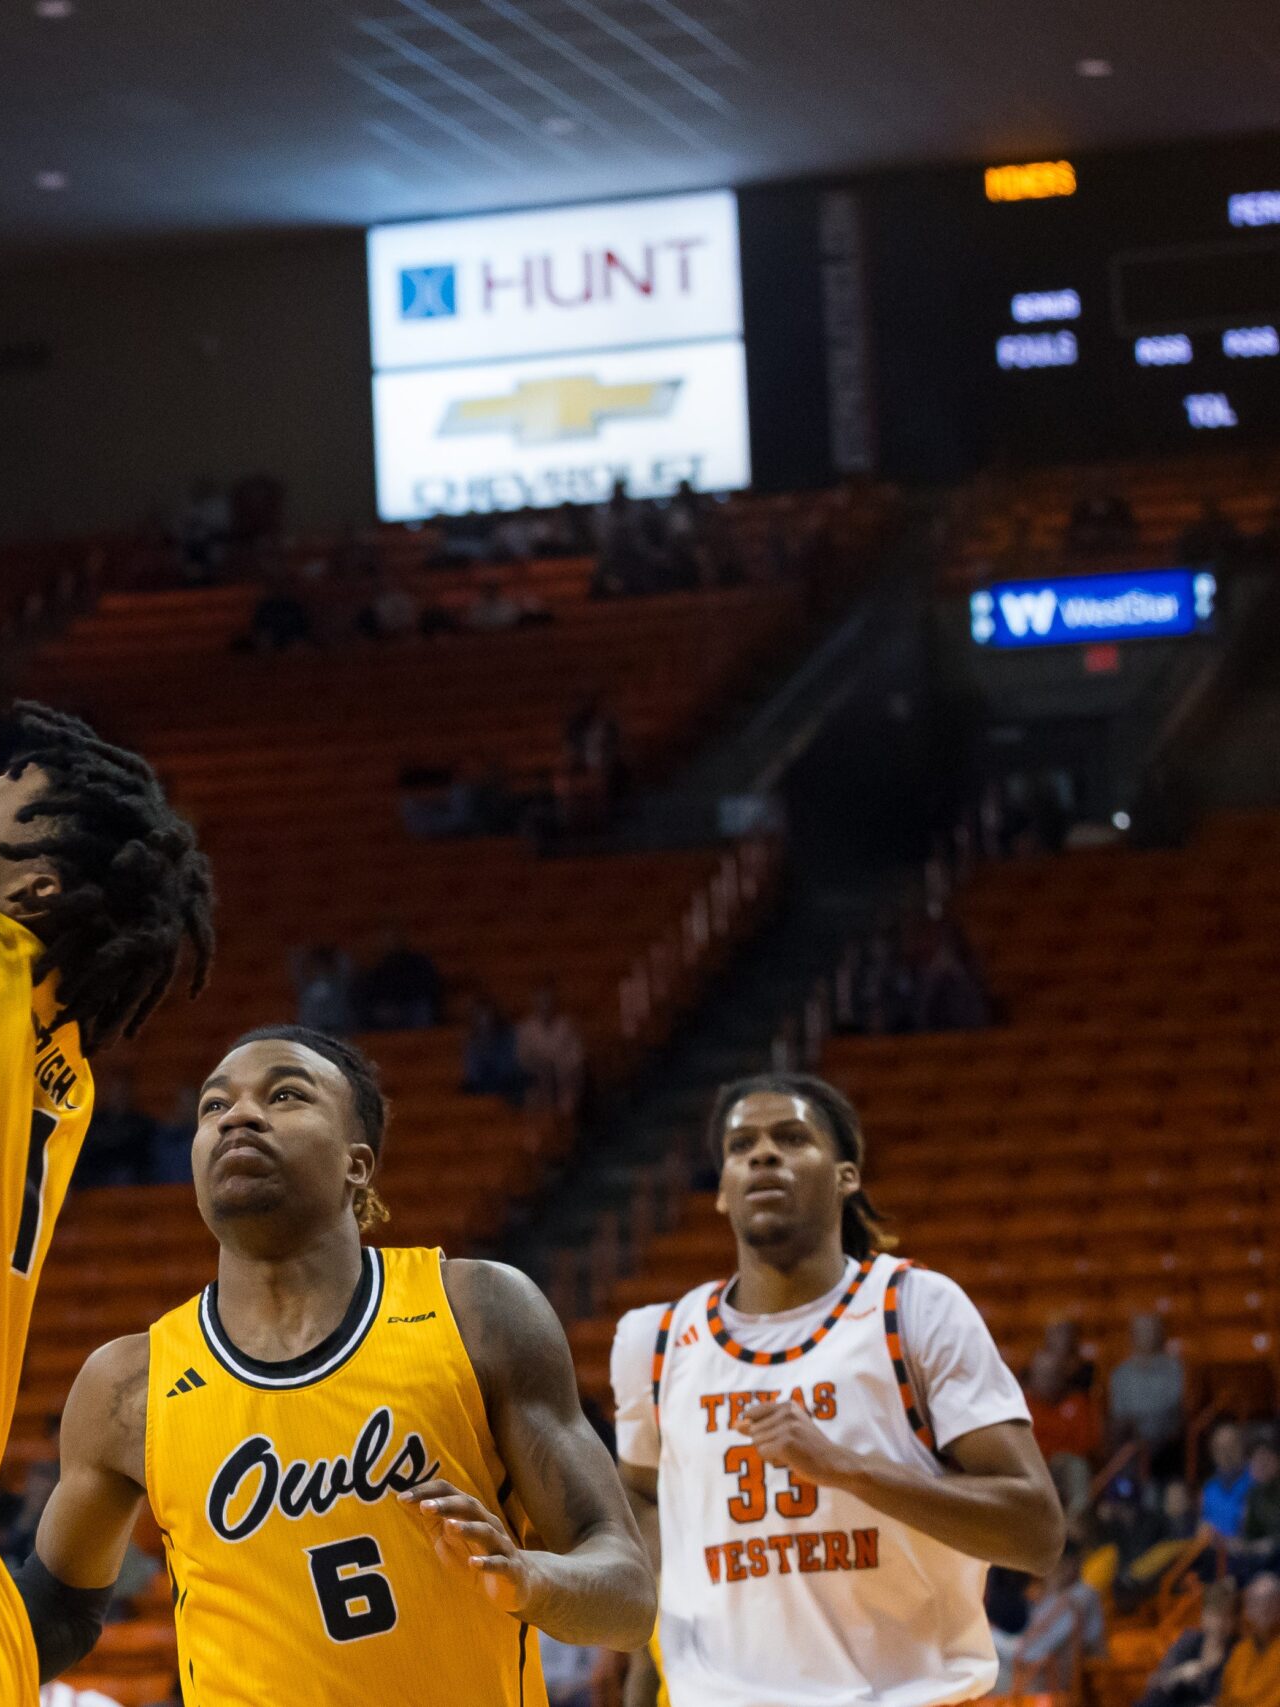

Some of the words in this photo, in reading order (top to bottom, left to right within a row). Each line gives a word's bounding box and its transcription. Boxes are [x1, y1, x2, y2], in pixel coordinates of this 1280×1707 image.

[482, 235, 708, 310] HUNT
[413, 456, 710, 508] CHEVROLET
[10, 1107, 60, 1281] 1
[205, 1405, 442, 1543] Owls
[302, 1534, 398, 1645] 6
